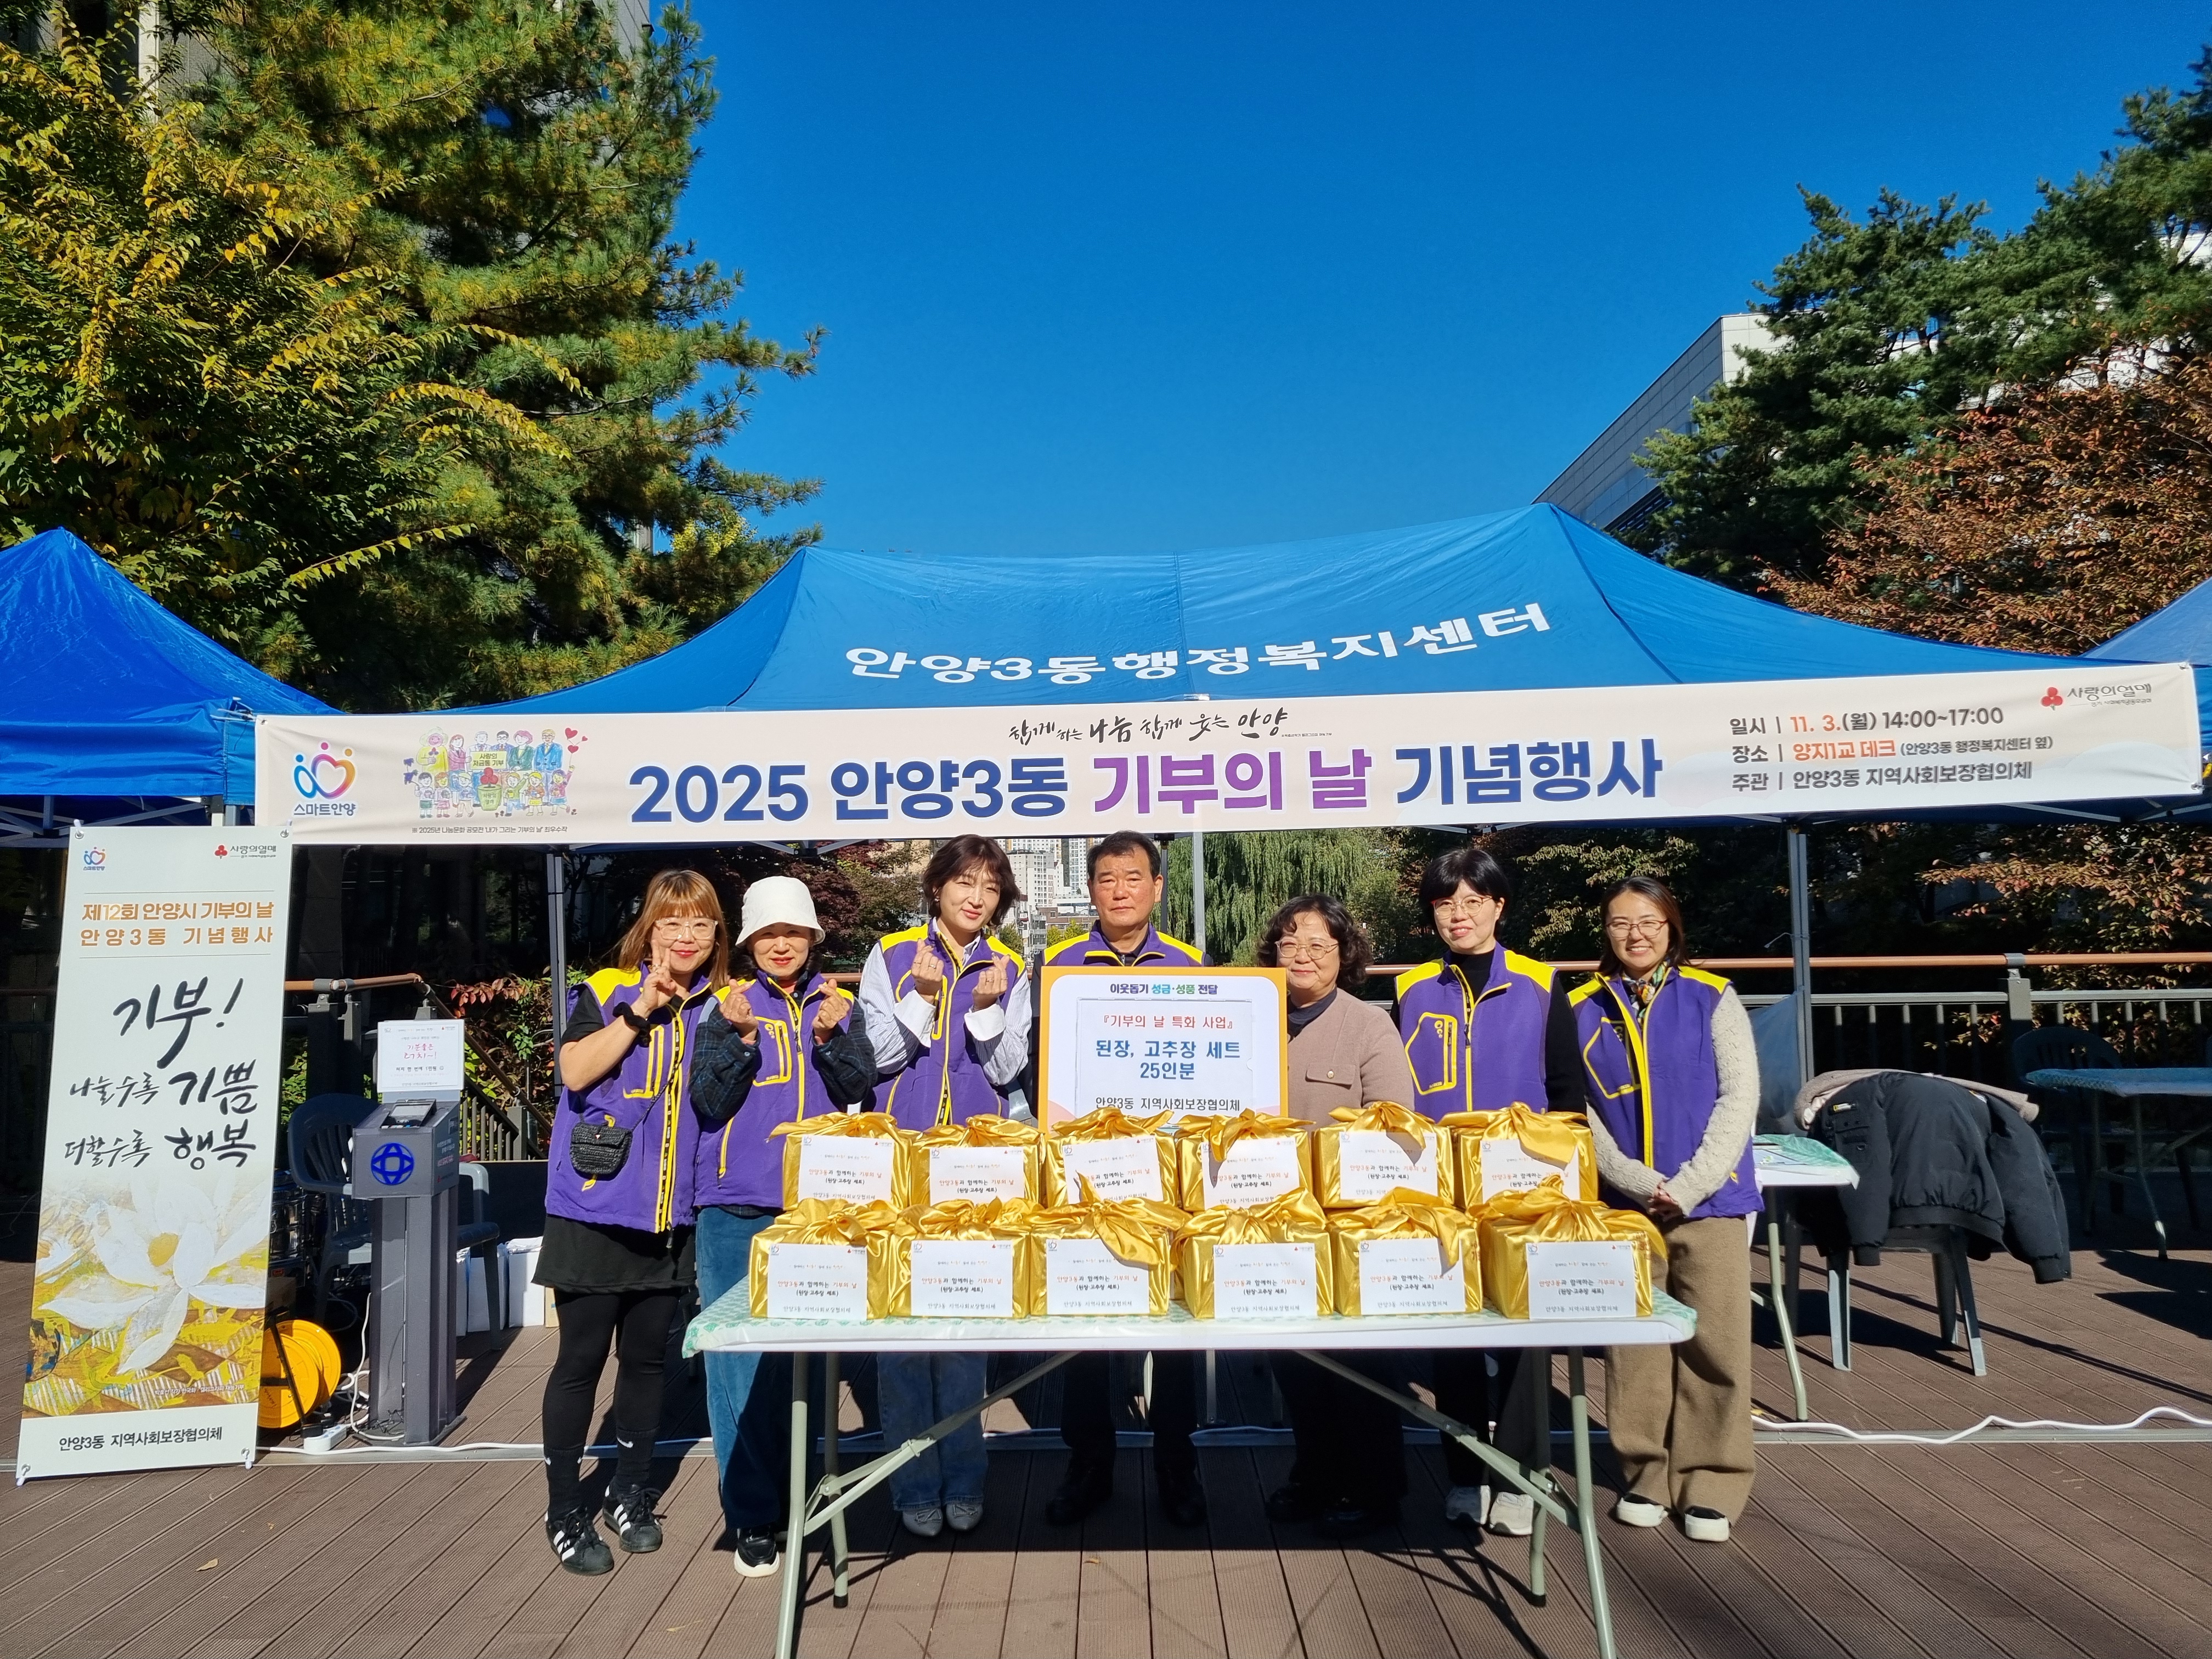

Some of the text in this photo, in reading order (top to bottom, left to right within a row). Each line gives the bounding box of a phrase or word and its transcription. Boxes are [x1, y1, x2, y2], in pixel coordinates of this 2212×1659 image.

[846, 603, 1551, 685] 안양3동행정복지센터
[2067, 684, 2152, 701] 사랑의열매
[1090, 716, 1133, 743] 나눔
[1140, 714, 1182, 740] 함께
[1189, 713, 1229, 741] 웃는
[1238, 707, 1288, 739] 안양
[1730, 718, 1766, 735] 일시
[1790, 716, 1814, 732] 11.
[1882, 707, 2004, 729] 14:00~17:00
[1733, 736, 2053, 763] 장소 양지1교 데크 (안양3동 행정복지센터 옆)
[629, 739, 1662, 822] 2025 안양3동 기부의 날 기념행사
[1732, 761, 2033, 792] 주관 안양3동 지역사회보장협의체
[293, 803, 356, 816] 스마트안양
[230, 845, 276, 854] 사랑의열매
[82, 901, 274, 921] 제12회 안양시 기부의 날
[81, 927, 273, 946] 안양3동 기념행사
[1110, 983, 1218, 995] 이웃돕기 성금·성품 전달
[114, 976, 244, 1069] 기부!
[1103, 1015, 1233, 1029] 『기부의 날 특화 사업』
[1096, 1040, 1240, 1059] 된장, 고추장 세트
[1140, 1062, 1195, 1080] 25인분
[70, 1059, 258, 1115] 나눌수록 기쁨
[1096, 1097, 1240, 1111] 안양3동 지역사회보장협의체
[65, 1119, 256, 1170] 더할수록 행복
[59, 1426, 223, 1452] 안양3동 지역사회보장협의체
